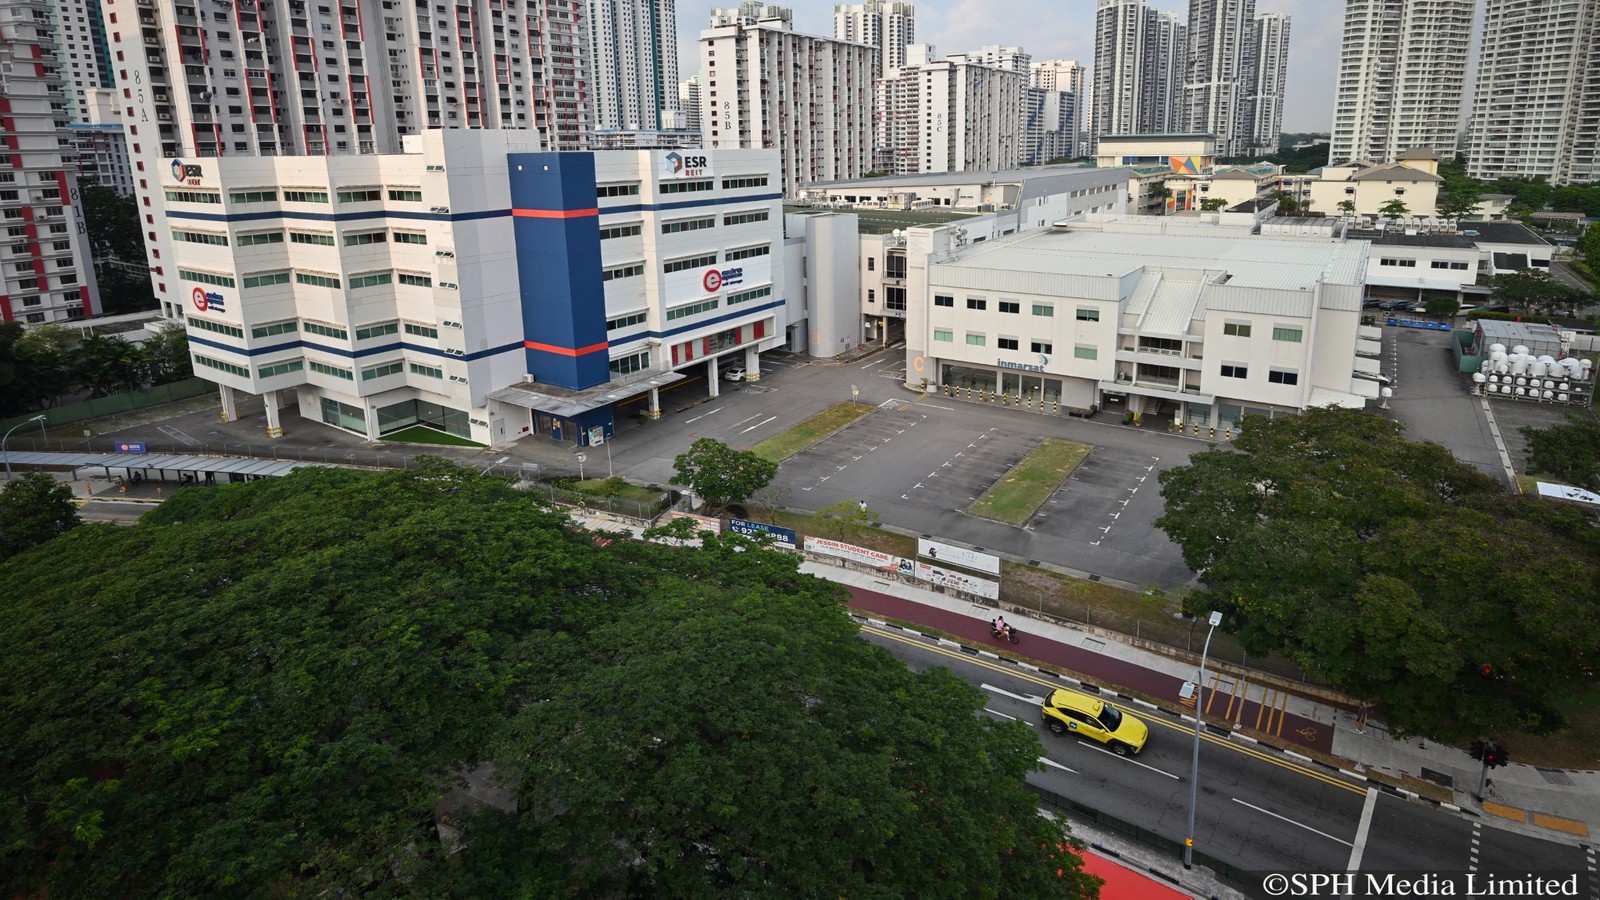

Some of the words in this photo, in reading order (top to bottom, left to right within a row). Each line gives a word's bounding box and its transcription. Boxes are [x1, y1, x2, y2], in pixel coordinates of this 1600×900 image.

[134, 69, 149, 122] 85A
[723, 100, 732, 130] 85B
[684, 156, 707, 168] ESR
[685, 169, 703, 177] REIT
[70, 187, 86, 235] 81B
[913, 356, 925, 372] C
[997, 358, 1045, 373] inmarsat
[731, 519, 746, 527] FOR
[747, 522, 769, 531] LEASE
[816, 539, 839, 548] JESSIN
[839, 543, 870, 555] STUDENT
[870, 551, 889, 561] CARE
